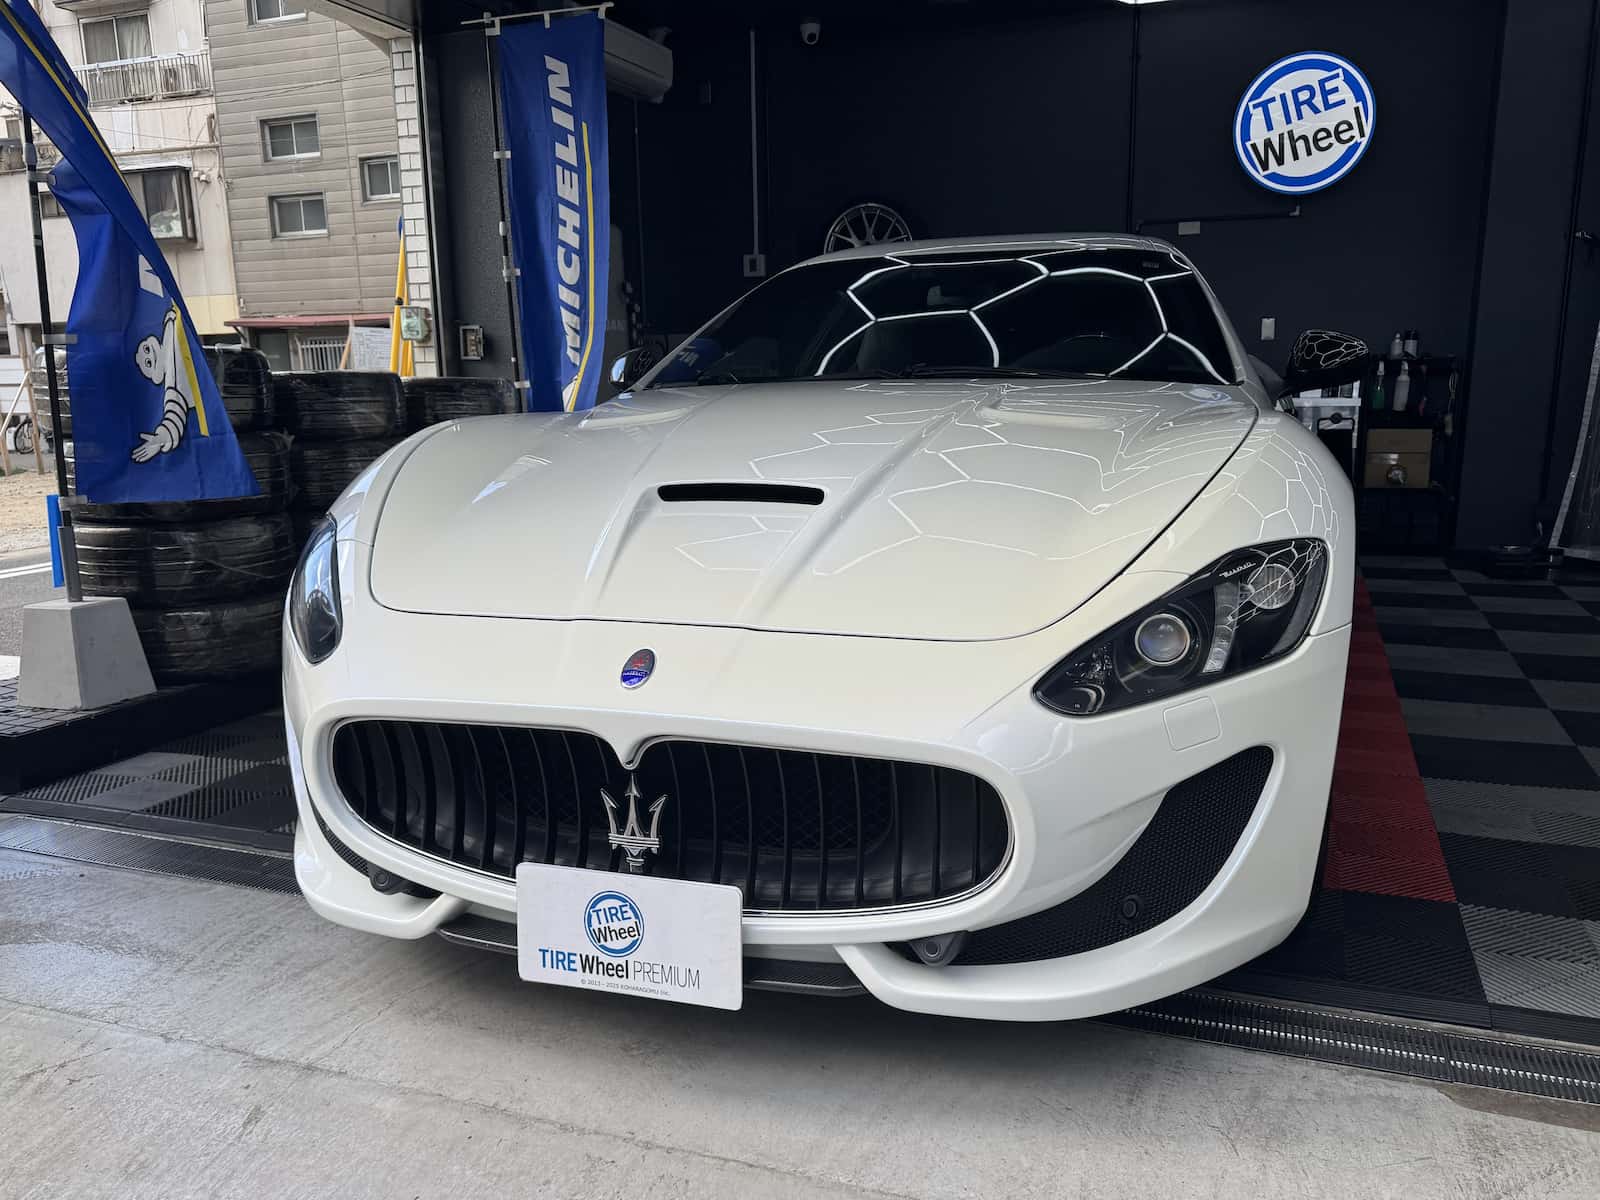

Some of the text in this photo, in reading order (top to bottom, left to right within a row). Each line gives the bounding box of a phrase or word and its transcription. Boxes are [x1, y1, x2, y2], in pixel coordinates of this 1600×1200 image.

[1252, 72, 1346, 132] TIRE
[1250, 106, 1365, 172] Wheel
[544, 55, 581, 367] MICHELIN
[591, 904, 632, 925] TIRE
[592, 921, 640, 943] Wheel
[538, 948, 700, 990] TIRE Wheel PREMIUM
